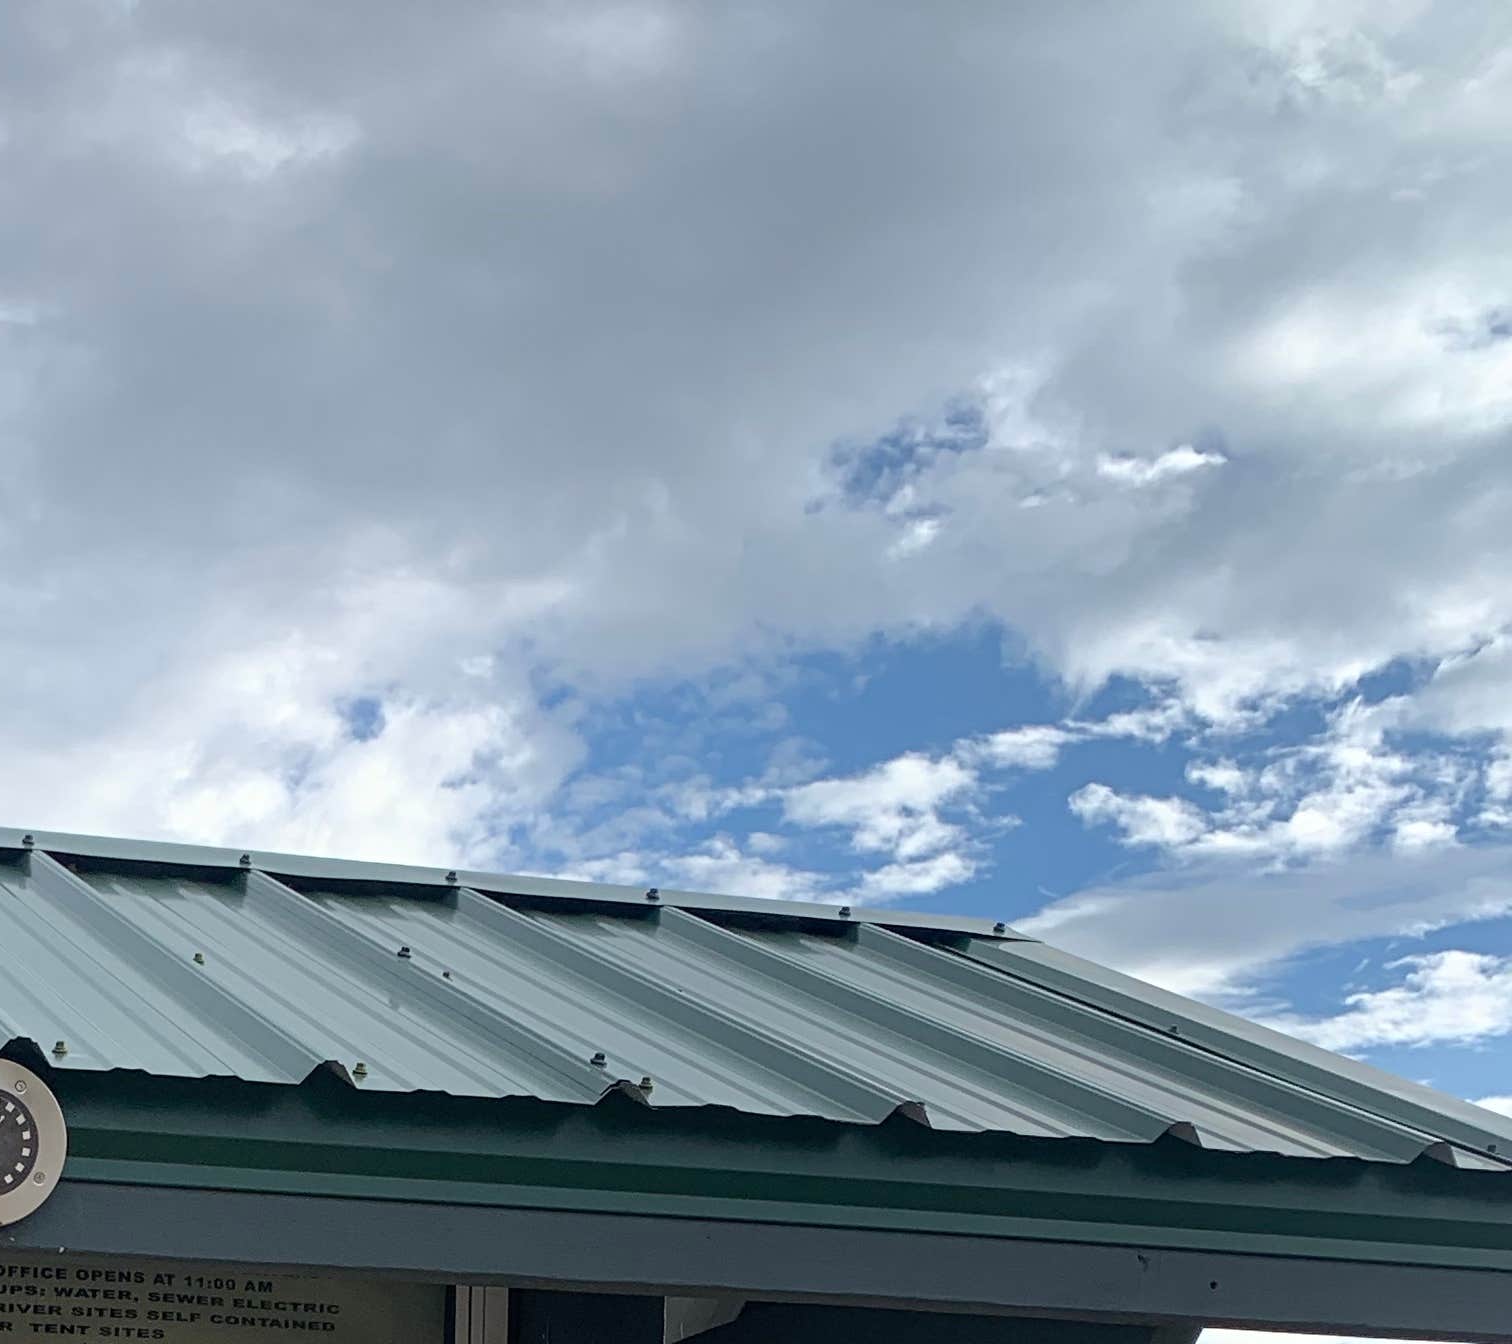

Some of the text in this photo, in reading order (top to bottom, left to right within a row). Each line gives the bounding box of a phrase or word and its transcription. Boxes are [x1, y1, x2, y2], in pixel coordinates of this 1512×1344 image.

[76, 1269, 145, 1284] OPENS
[153, 1273, 176, 1287] AT
[183, 1275, 235, 1291] 11:00
[245, 1279, 274, 1293] AM
[54, 1287, 139, 1303] WATER,
[148, 1292, 224, 1308] SEWER
[232, 1298, 340, 1315] ELECTRIC
[28, 1322, 91, 1338] TENT
[98, 1325, 166, 1341] SITES
[71, 1306, 137, 1320] SITES
[147, 1310, 201, 1323] SELF
[210, 1314, 337, 1332] CONTAINED
